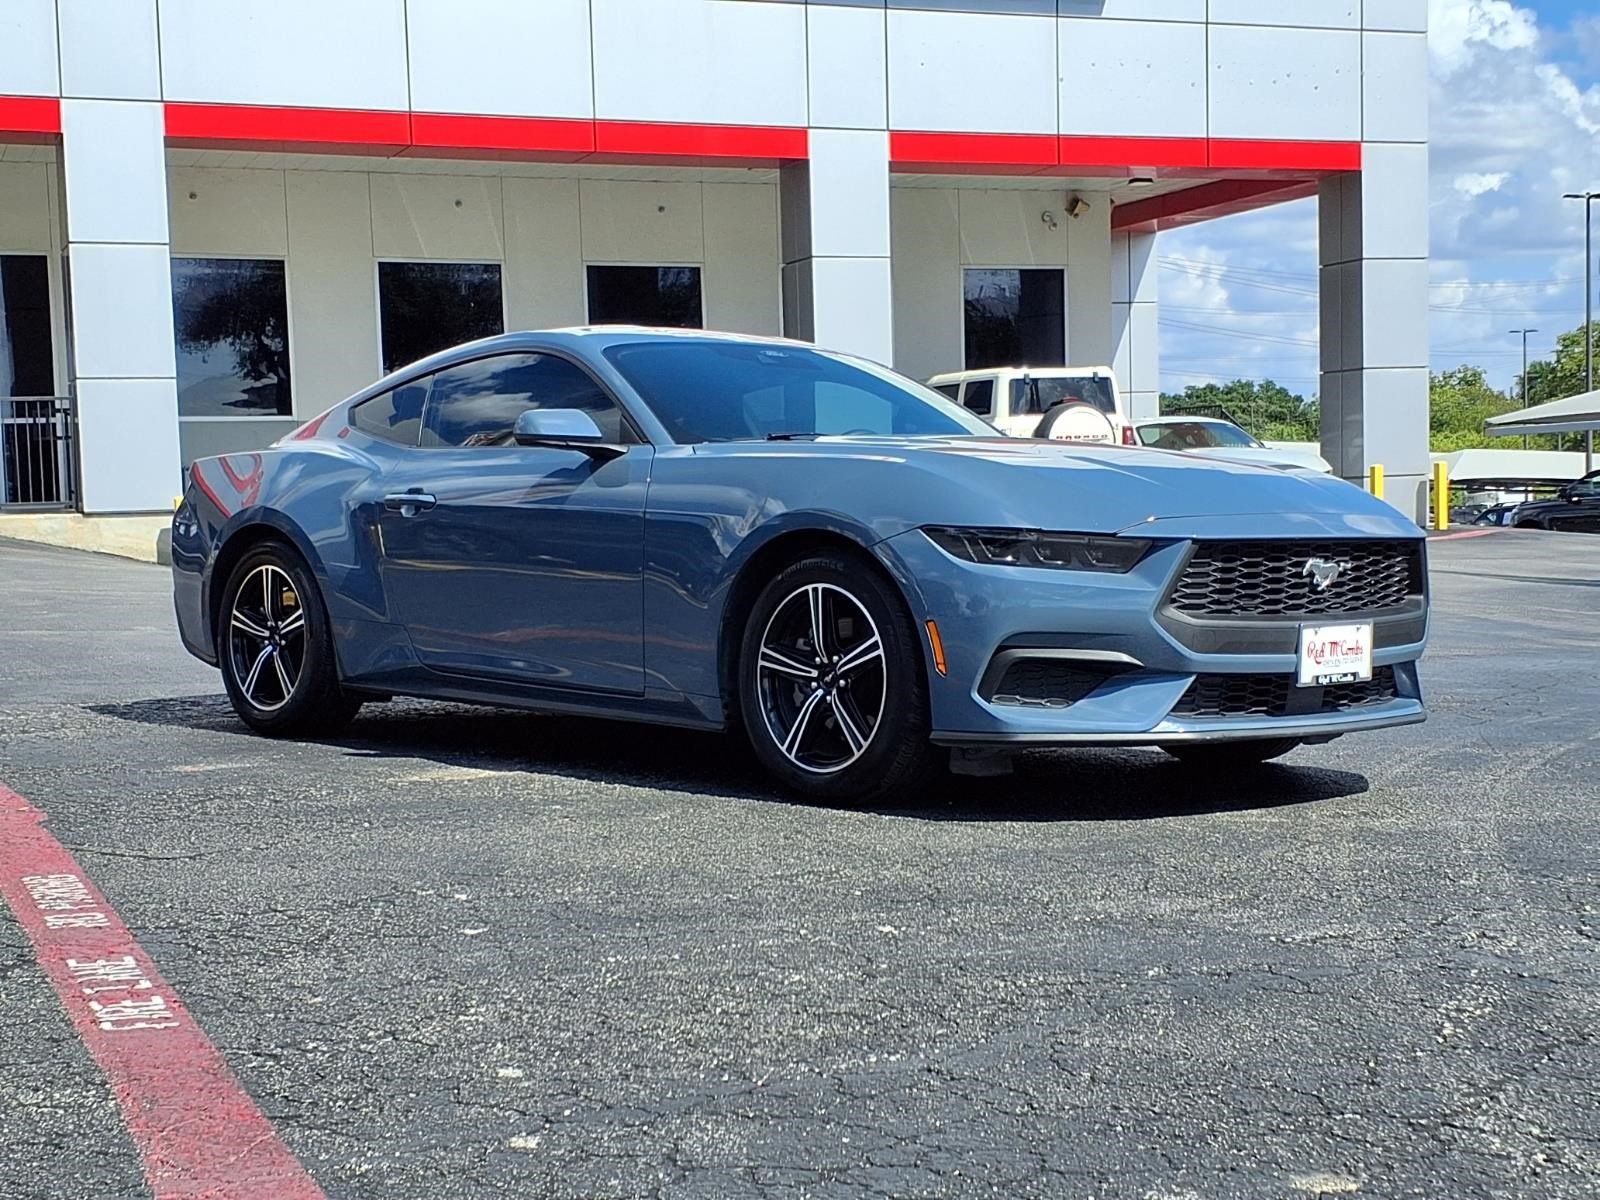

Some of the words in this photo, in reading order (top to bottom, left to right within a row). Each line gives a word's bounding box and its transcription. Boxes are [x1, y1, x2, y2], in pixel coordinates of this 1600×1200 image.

[1308, 641, 1326, 664] Red
[20, 874, 98, 910] PARKING
[44, 912, 111, 930] NO
[66, 956, 153, 995] LANE
[89, 995, 180, 1031] FIRE
